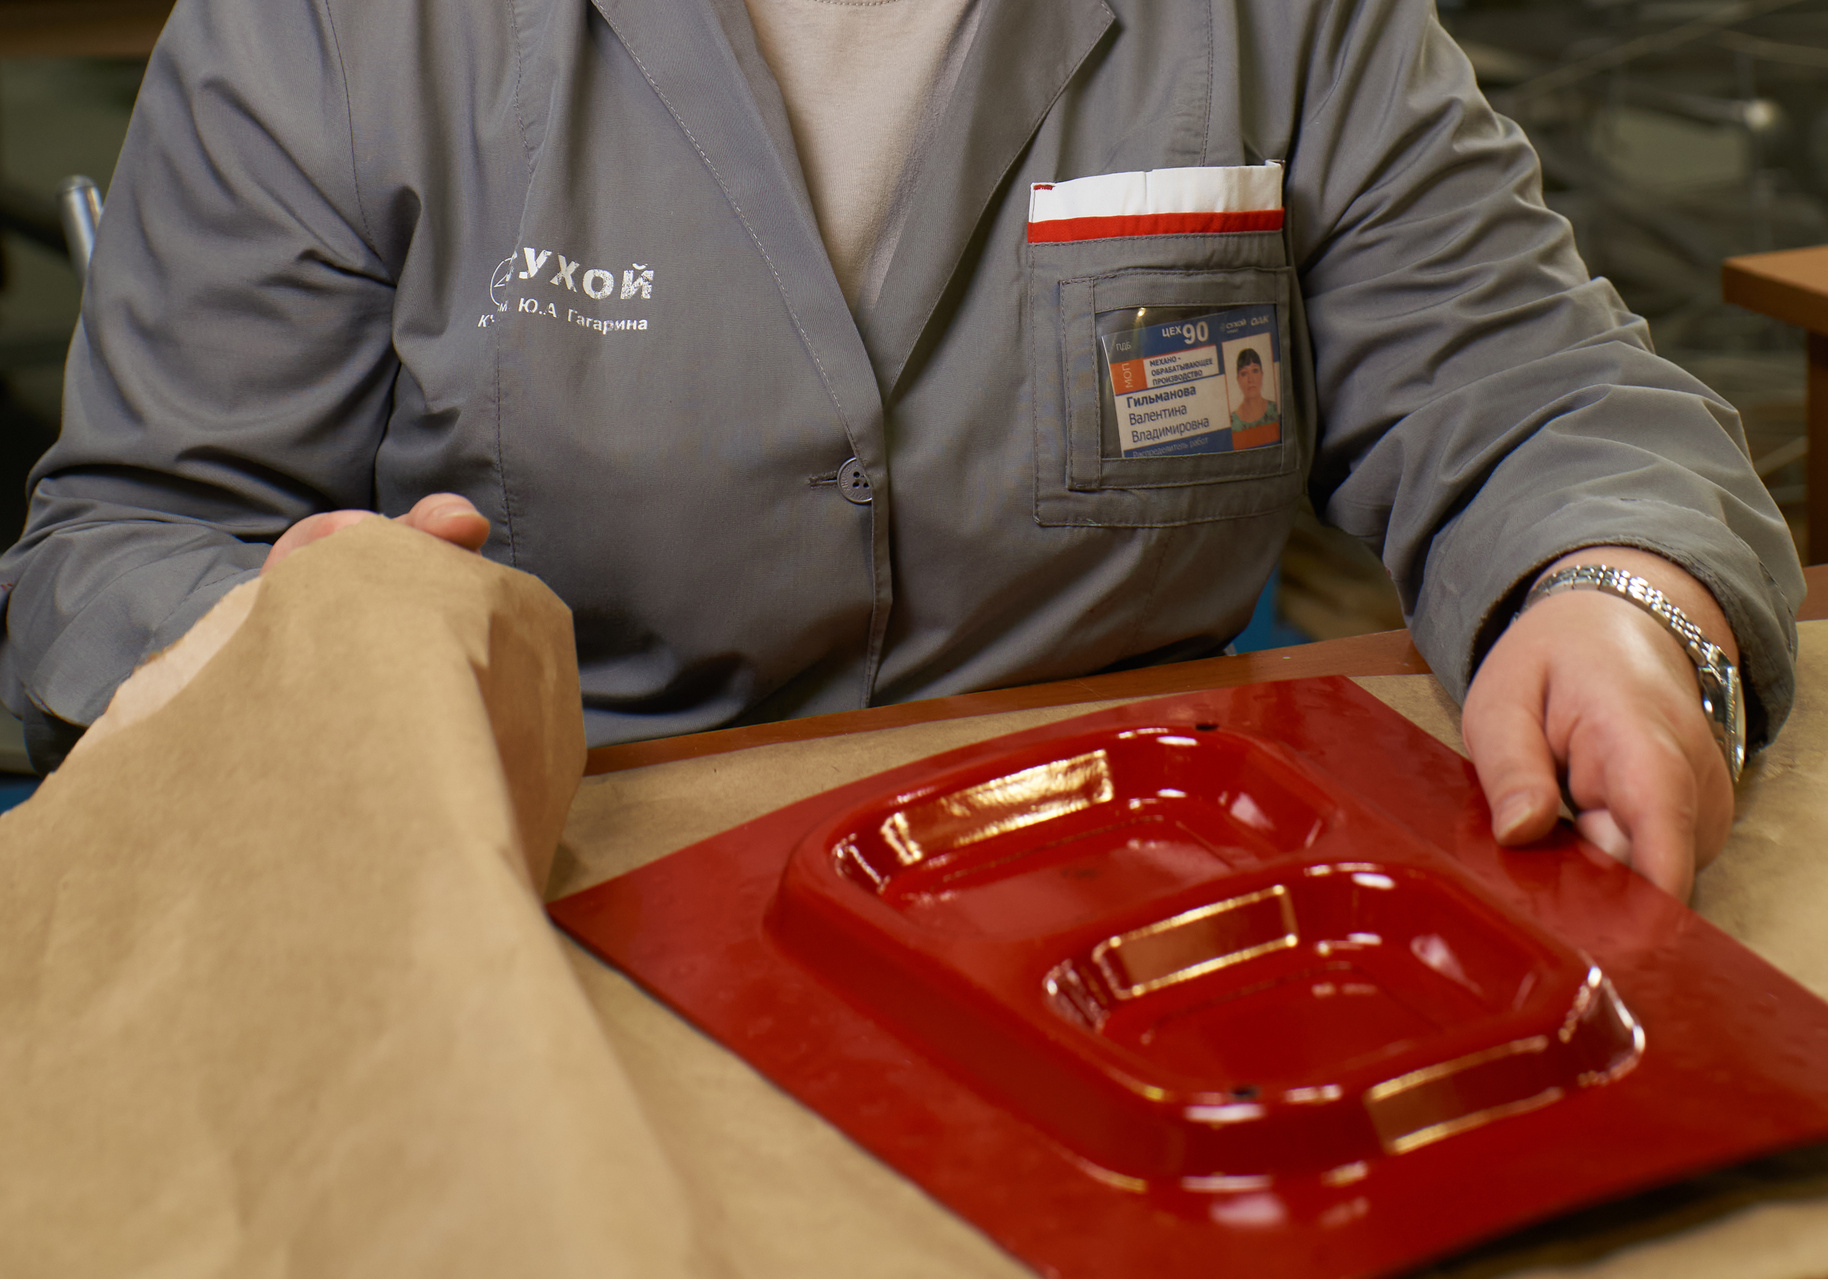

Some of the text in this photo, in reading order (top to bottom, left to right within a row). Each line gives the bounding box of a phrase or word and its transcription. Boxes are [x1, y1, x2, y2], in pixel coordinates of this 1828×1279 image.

[568, 308, 648, 335] Гагарина
[1162, 320, 1209, 345] ЦЕХ 90
[1151, 357, 1213, 377] ОБРАБАТЫВАЮЩЕЕ
[1152, 370, 1203, 386] ПРОИЗВОДСТВО
[1126, 385, 1197, 408] Гильманова
[1129, 404, 1188, 425] Валентина
[1131, 417, 1210, 443] Владимировна
